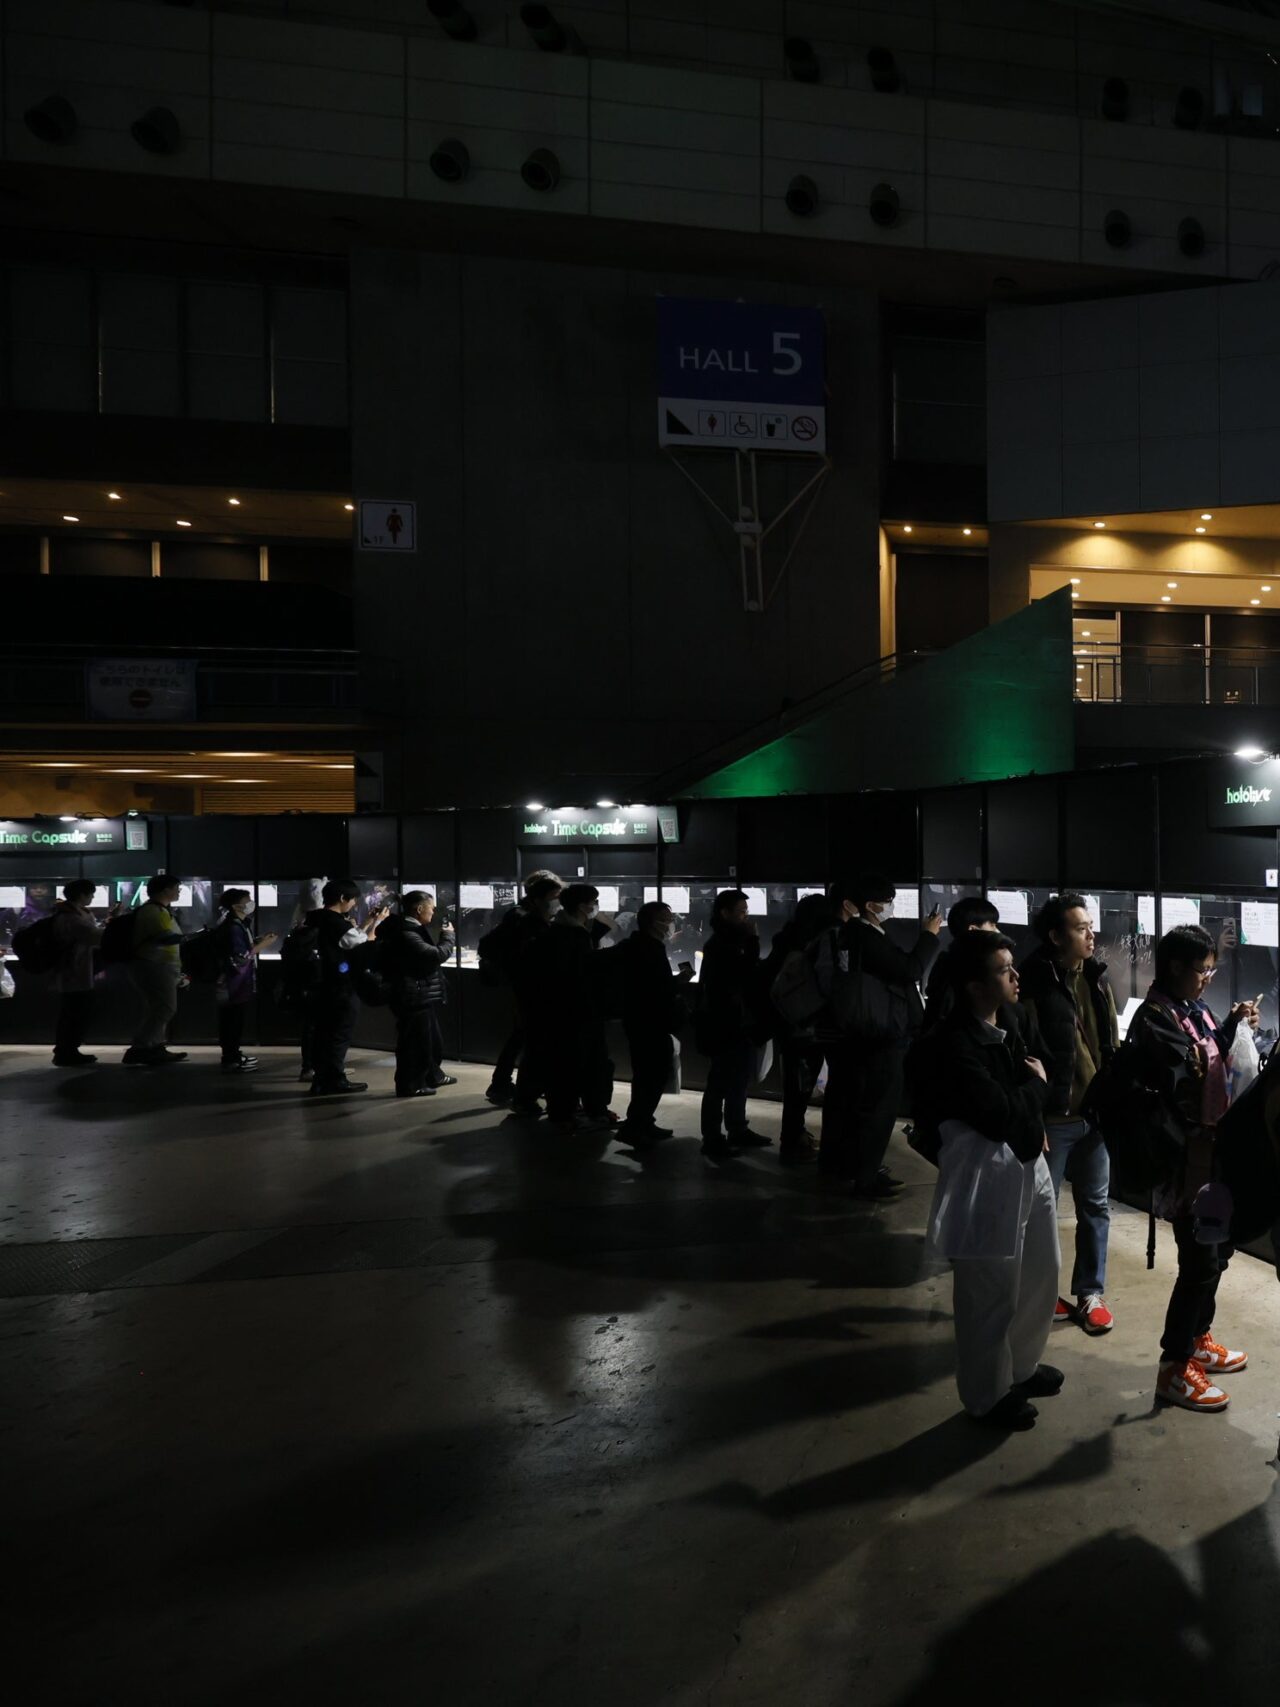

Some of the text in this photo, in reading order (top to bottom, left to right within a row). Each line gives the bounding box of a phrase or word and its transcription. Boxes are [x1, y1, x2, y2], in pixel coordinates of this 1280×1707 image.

[679, 331, 803, 376] HALL 5
[31, 829, 89, 845] Capsule
[551, 819, 577, 838] Time
[580, 818, 628, 838] Capsule
